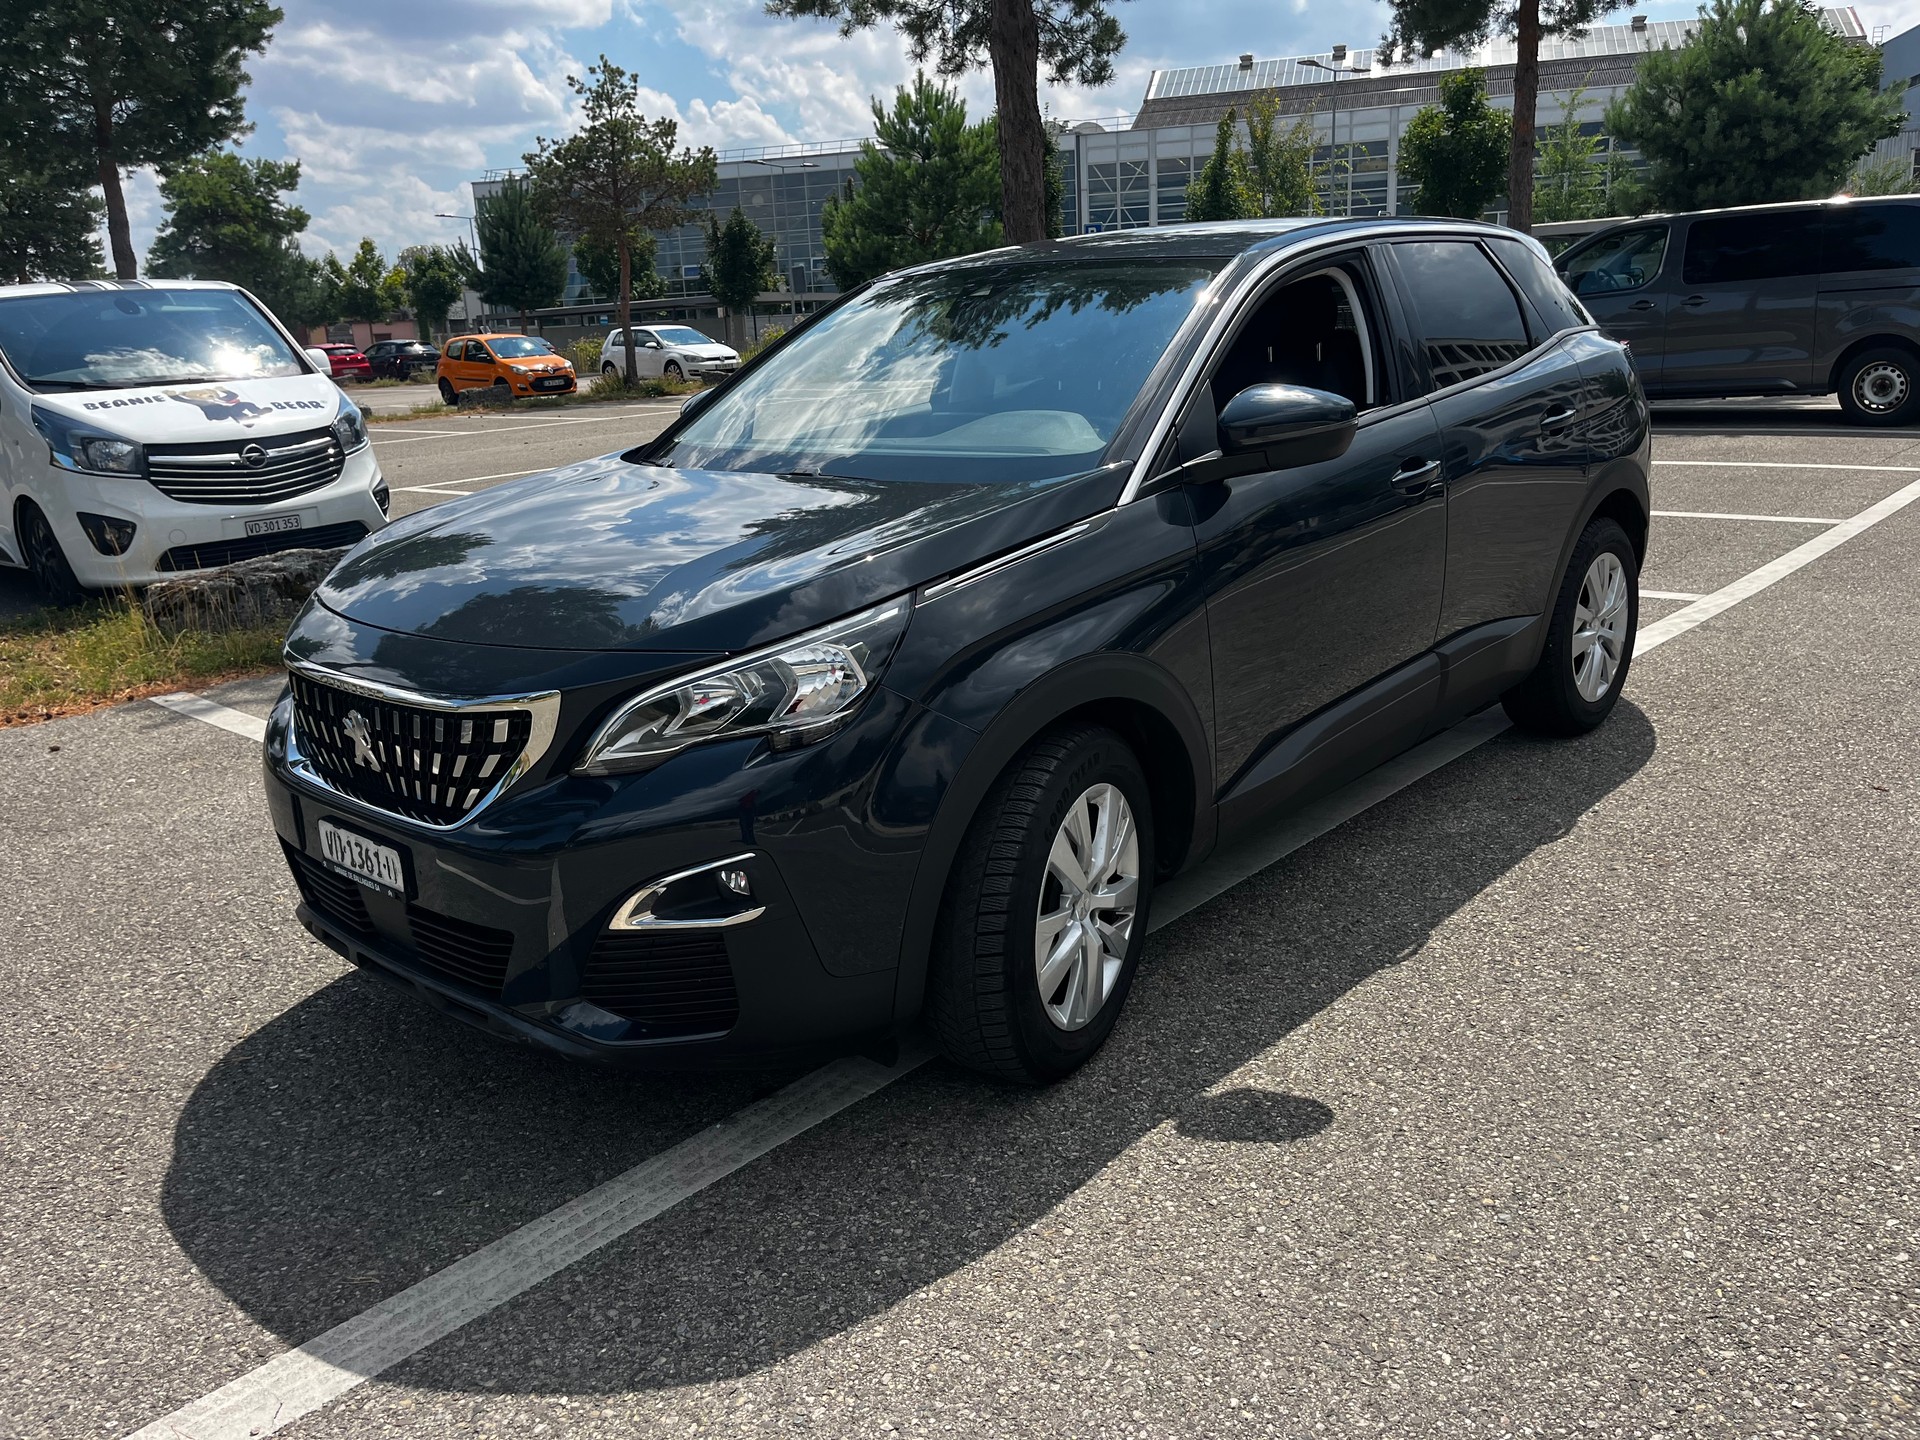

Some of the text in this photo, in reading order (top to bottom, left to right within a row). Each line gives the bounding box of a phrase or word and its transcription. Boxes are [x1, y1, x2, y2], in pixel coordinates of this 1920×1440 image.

[83, 394, 325, 411] BEANIE BEAR
[282, 517, 300, 530] 353
